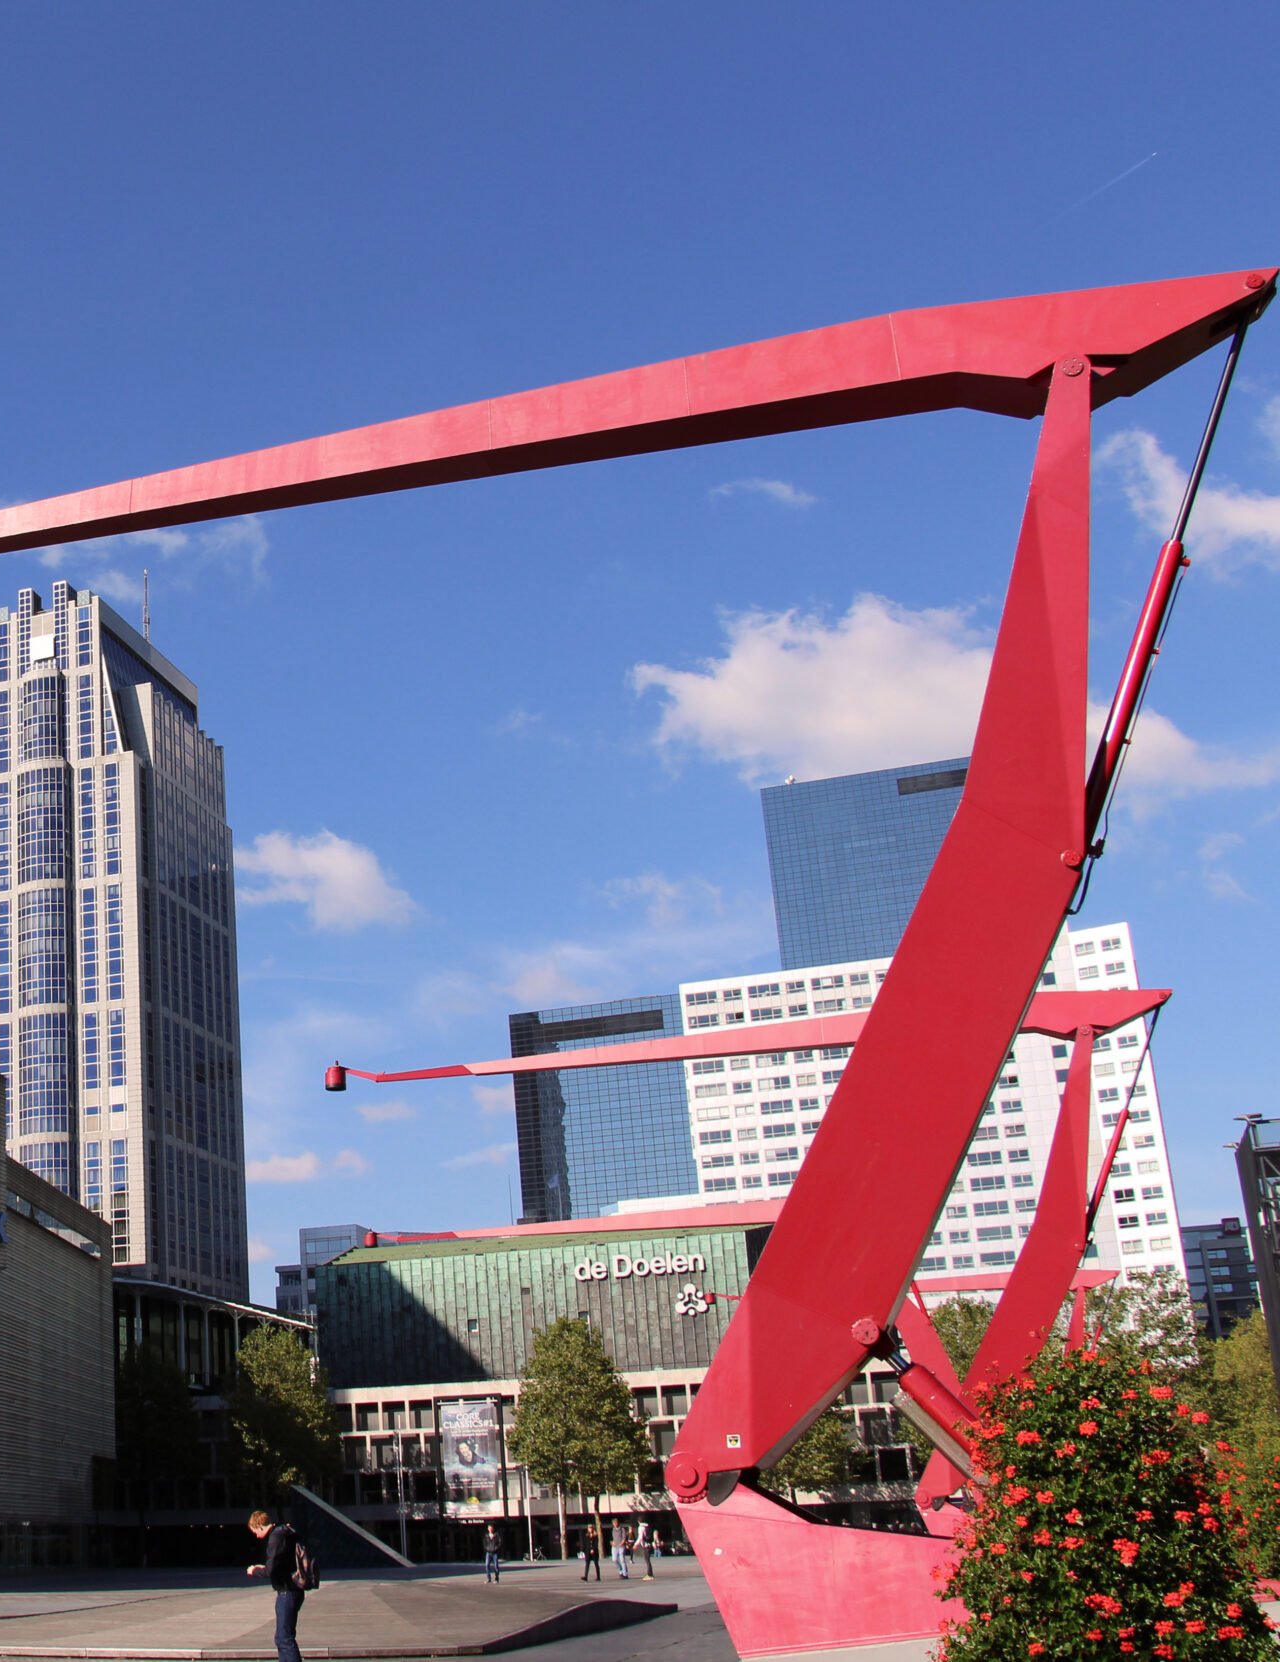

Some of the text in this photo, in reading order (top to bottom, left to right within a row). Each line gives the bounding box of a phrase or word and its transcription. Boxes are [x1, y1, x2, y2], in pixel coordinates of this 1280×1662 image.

[574, 1250, 707, 1281] de Doelen
[456, 1412, 480, 1421] CORE
